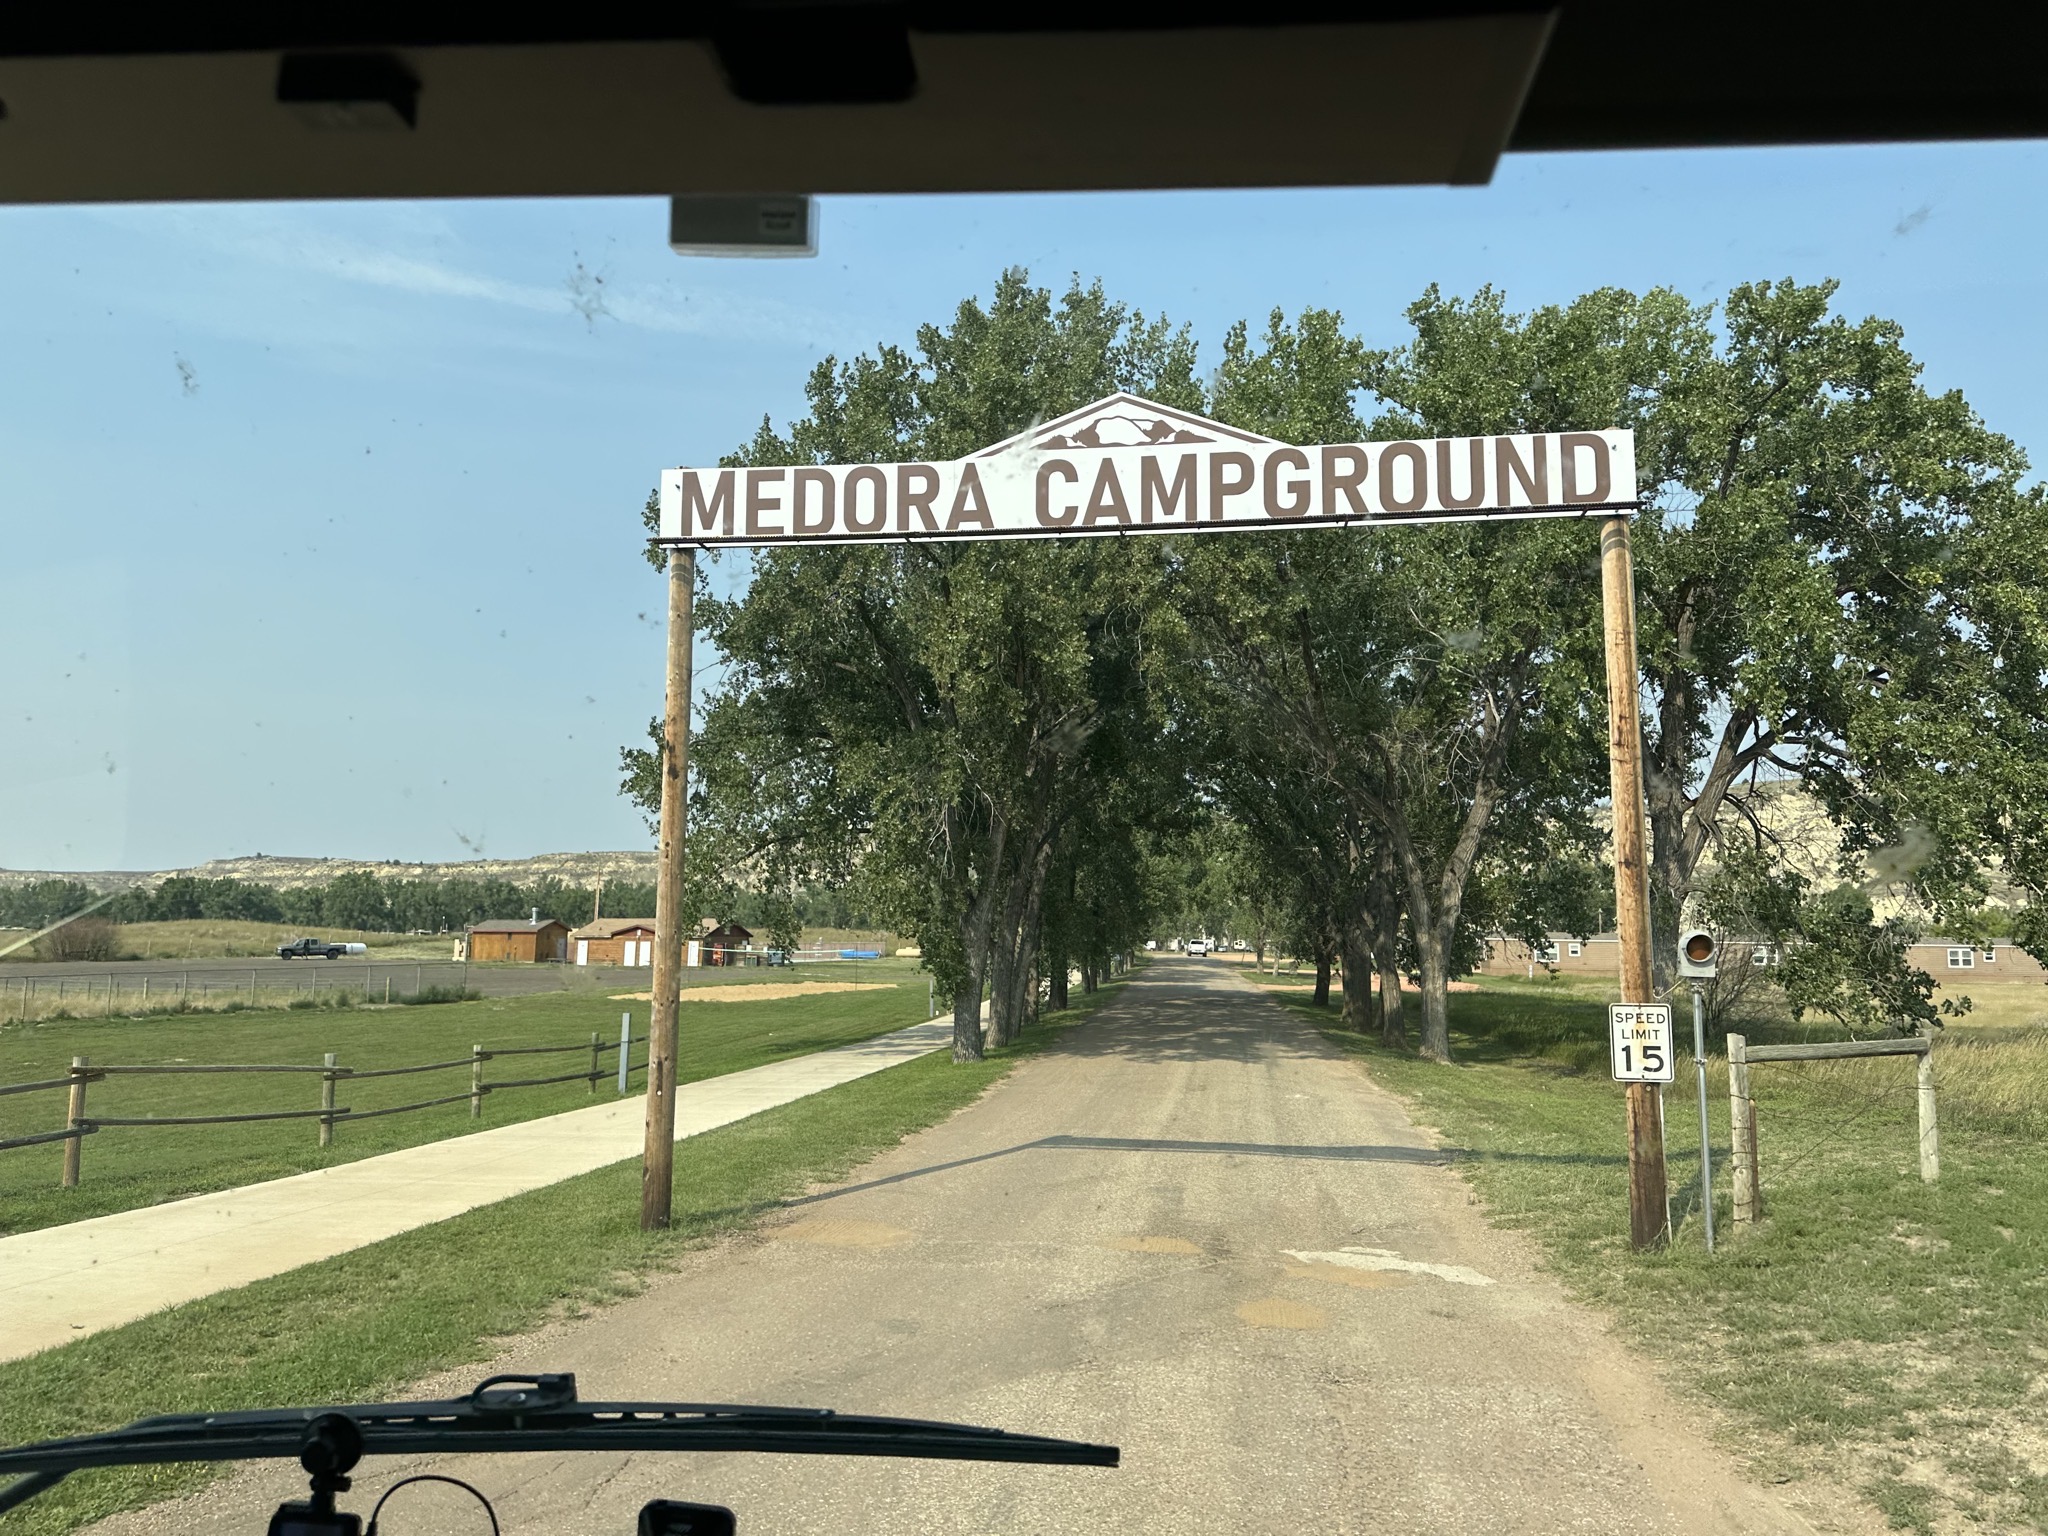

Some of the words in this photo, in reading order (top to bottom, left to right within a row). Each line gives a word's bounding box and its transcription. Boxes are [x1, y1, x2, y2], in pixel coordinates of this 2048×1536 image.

[681, 462, 995, 537] MEDORA
[1035, 433, 1611, 528] CAMPGROUND
[1615, 1012, 1666, 1024] SPEED
[1621, 1029, 1660, 1040] LIMIT
[1621, 1045, 1664, 1073] 15
